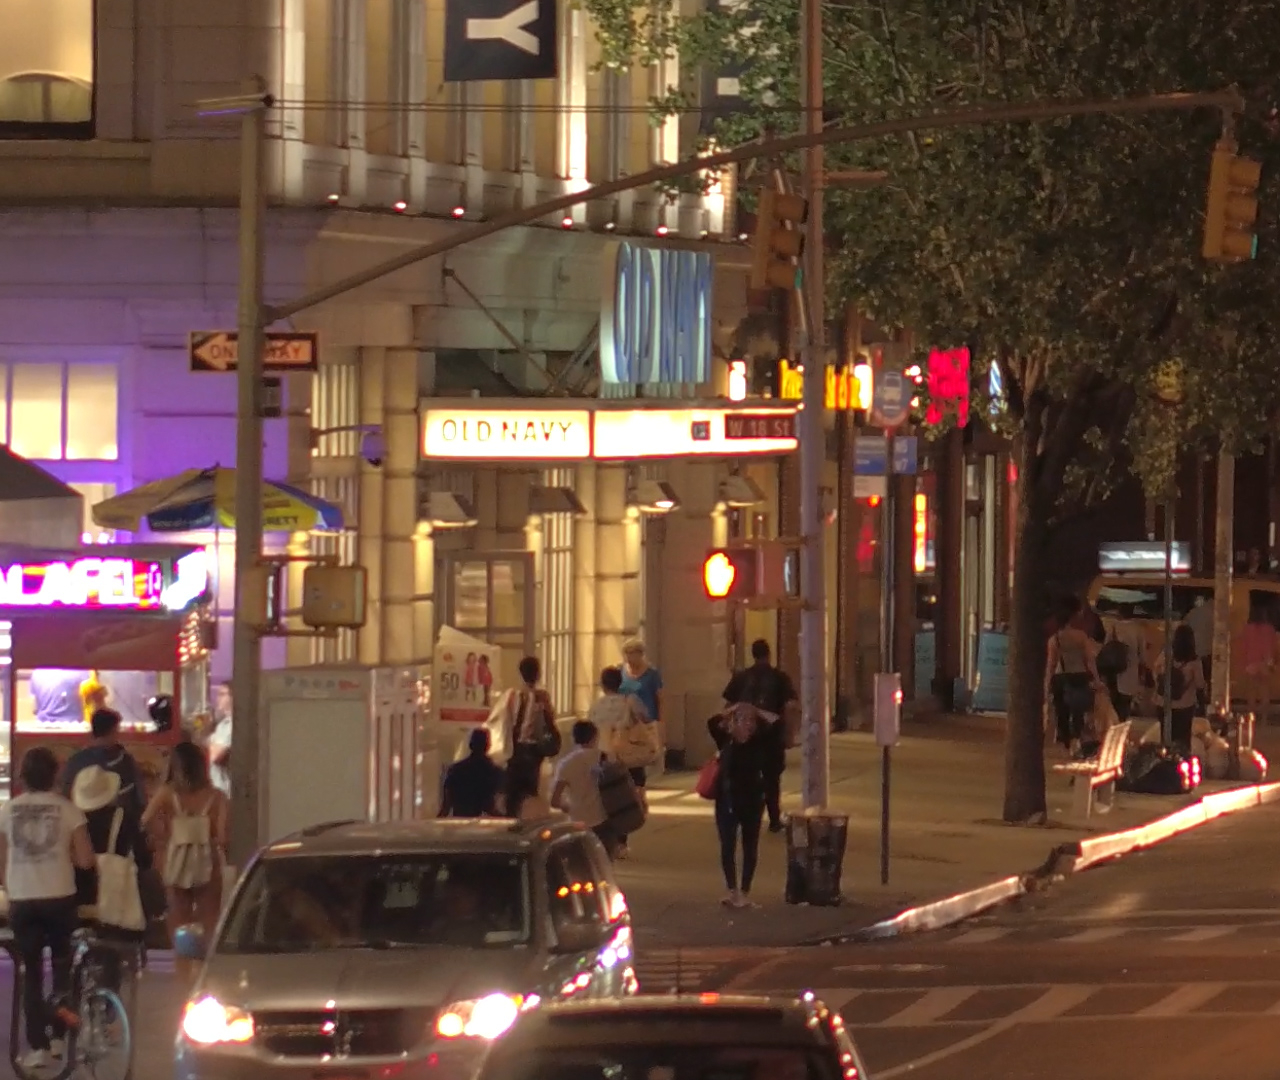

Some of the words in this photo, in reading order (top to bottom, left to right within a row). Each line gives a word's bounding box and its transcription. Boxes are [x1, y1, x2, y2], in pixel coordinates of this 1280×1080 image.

[442, 419, 492, 442] OLD
[502, 421, 572, 442] NAVY
[729, 421, 743, 437] W
[751, 421, 767, 437] 18
[774, 421, 791, 437] St
